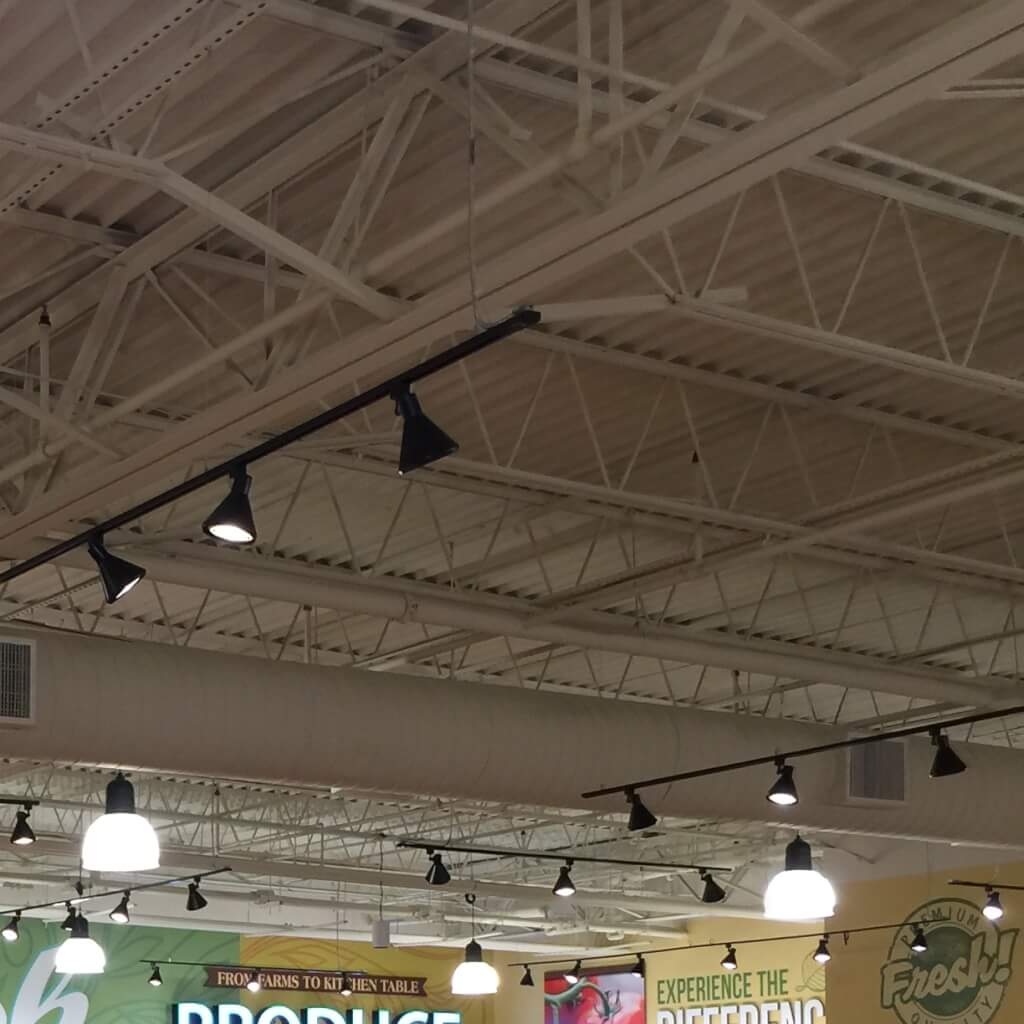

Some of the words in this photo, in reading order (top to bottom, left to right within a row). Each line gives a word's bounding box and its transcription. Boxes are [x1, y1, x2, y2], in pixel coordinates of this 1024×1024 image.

[900, 906, 980, 948] PEMIUM
[257, 974, 300, 989] FARMS
[304, 975, 320, 990] TO
[324, 976, 378, 993] KITHEN
[380, 978, 419, 994] TABLE
[657, 972, 752, 1005] EXPERIENCE
[757, 968, 789, 997] THE
[880, 927, 1021, 1009] Fresh!
